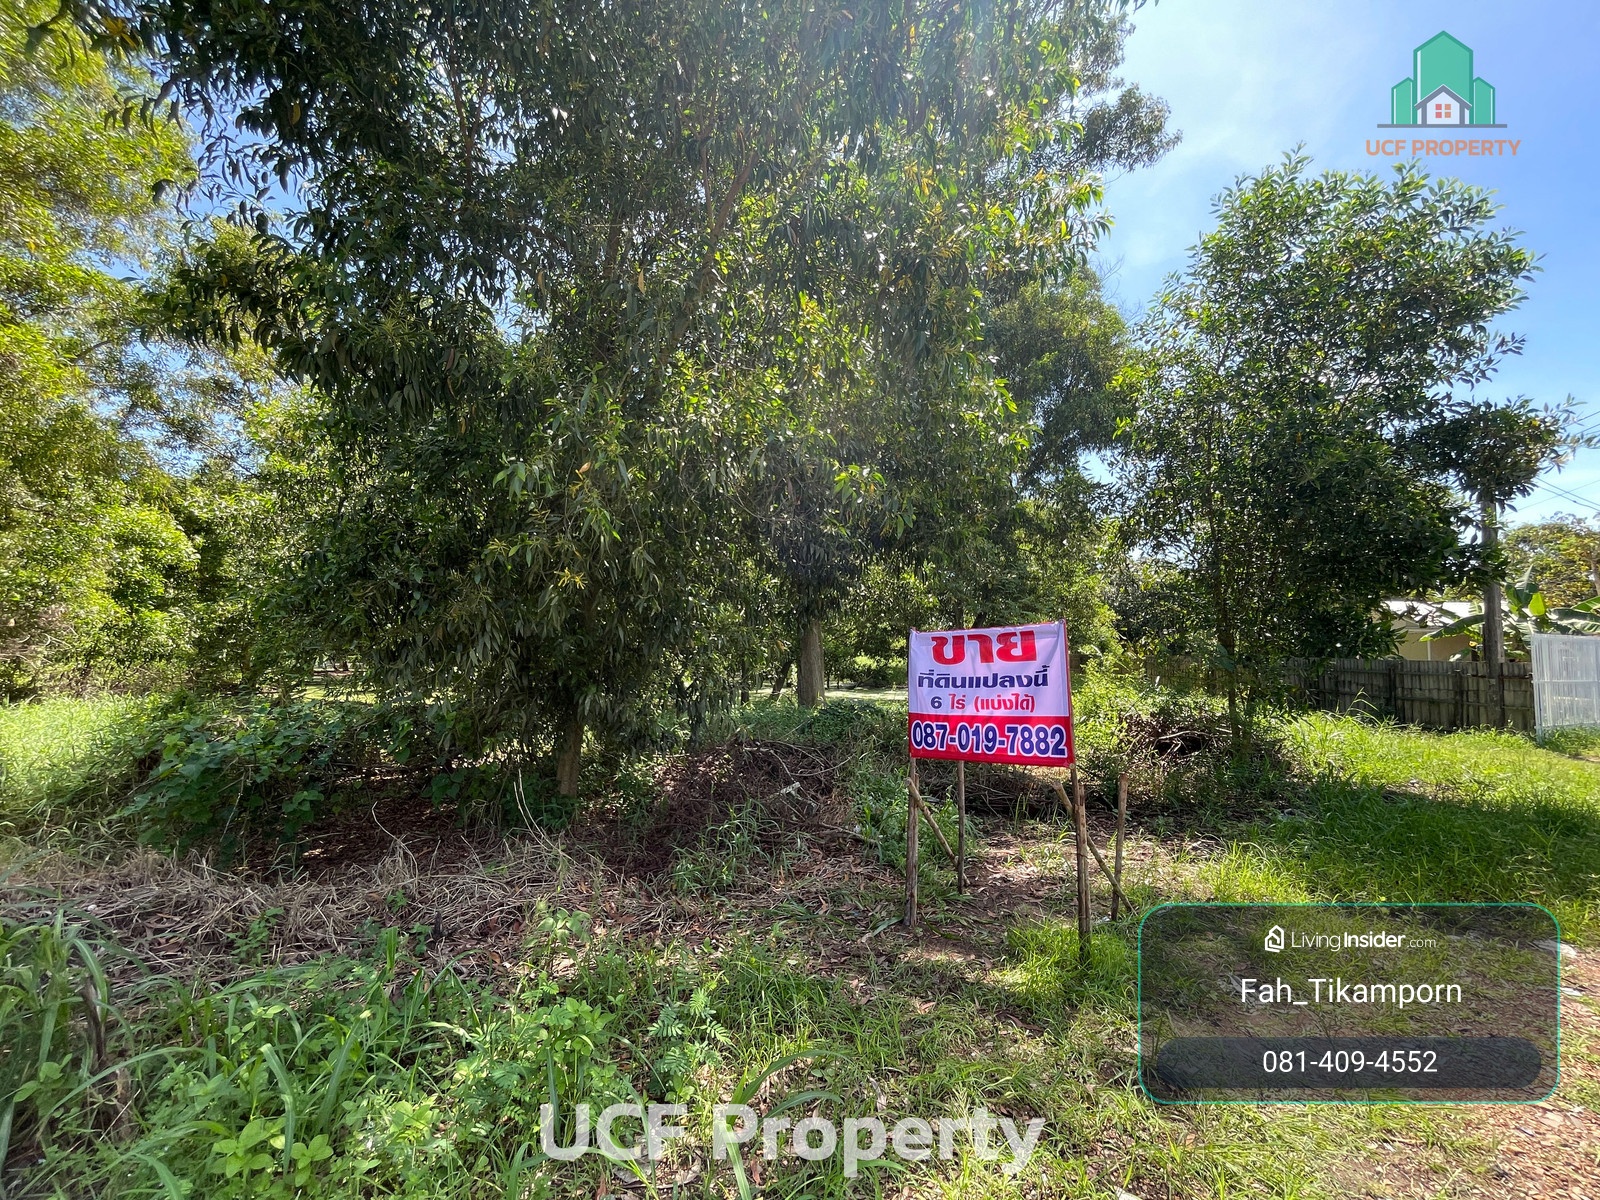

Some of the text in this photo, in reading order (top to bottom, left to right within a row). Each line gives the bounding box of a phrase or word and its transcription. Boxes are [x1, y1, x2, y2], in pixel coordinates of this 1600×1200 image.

[930, 630, 1037, 666] ขาย
[917, 665, 1050, 689] ที่ดินแปลงนี้
[930, 693, 1036, 713] 6 ไร่ (แบ่งได้)
[912, 720, 1068, 758] 087-019-7882
